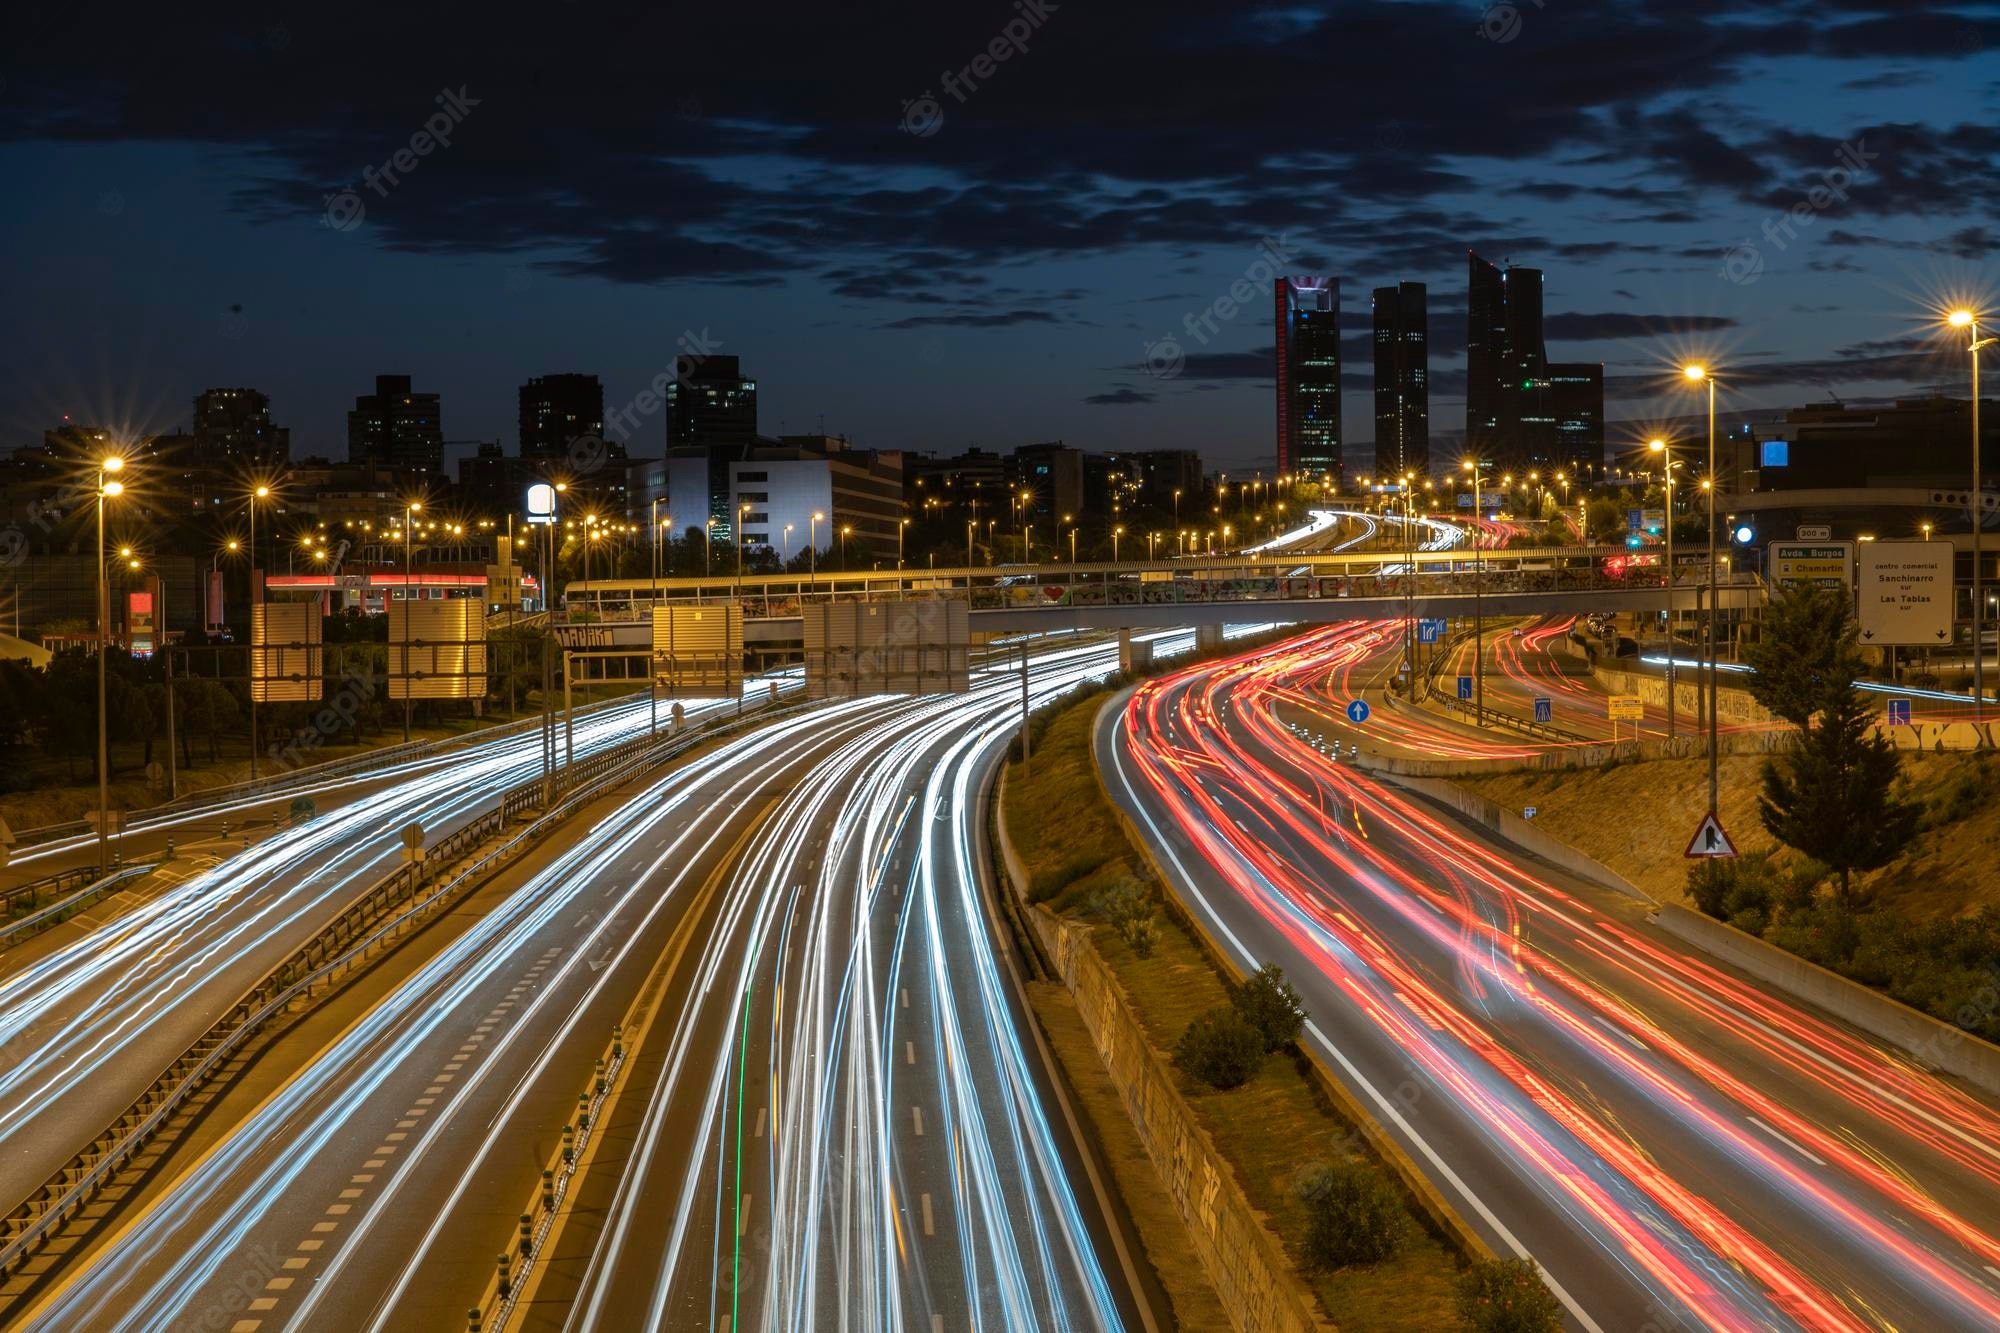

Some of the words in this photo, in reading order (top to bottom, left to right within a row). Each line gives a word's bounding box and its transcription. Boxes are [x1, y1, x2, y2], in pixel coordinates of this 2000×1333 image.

[1811, 549, 1843, 559] Burgos
[1902, 562, 1938, 570] comercial
[1879, 574, 1934, 582] Sanchinarro
[1880, 595, 1896, 603] Las
[1901, 595, 1931, 603] Tablas
